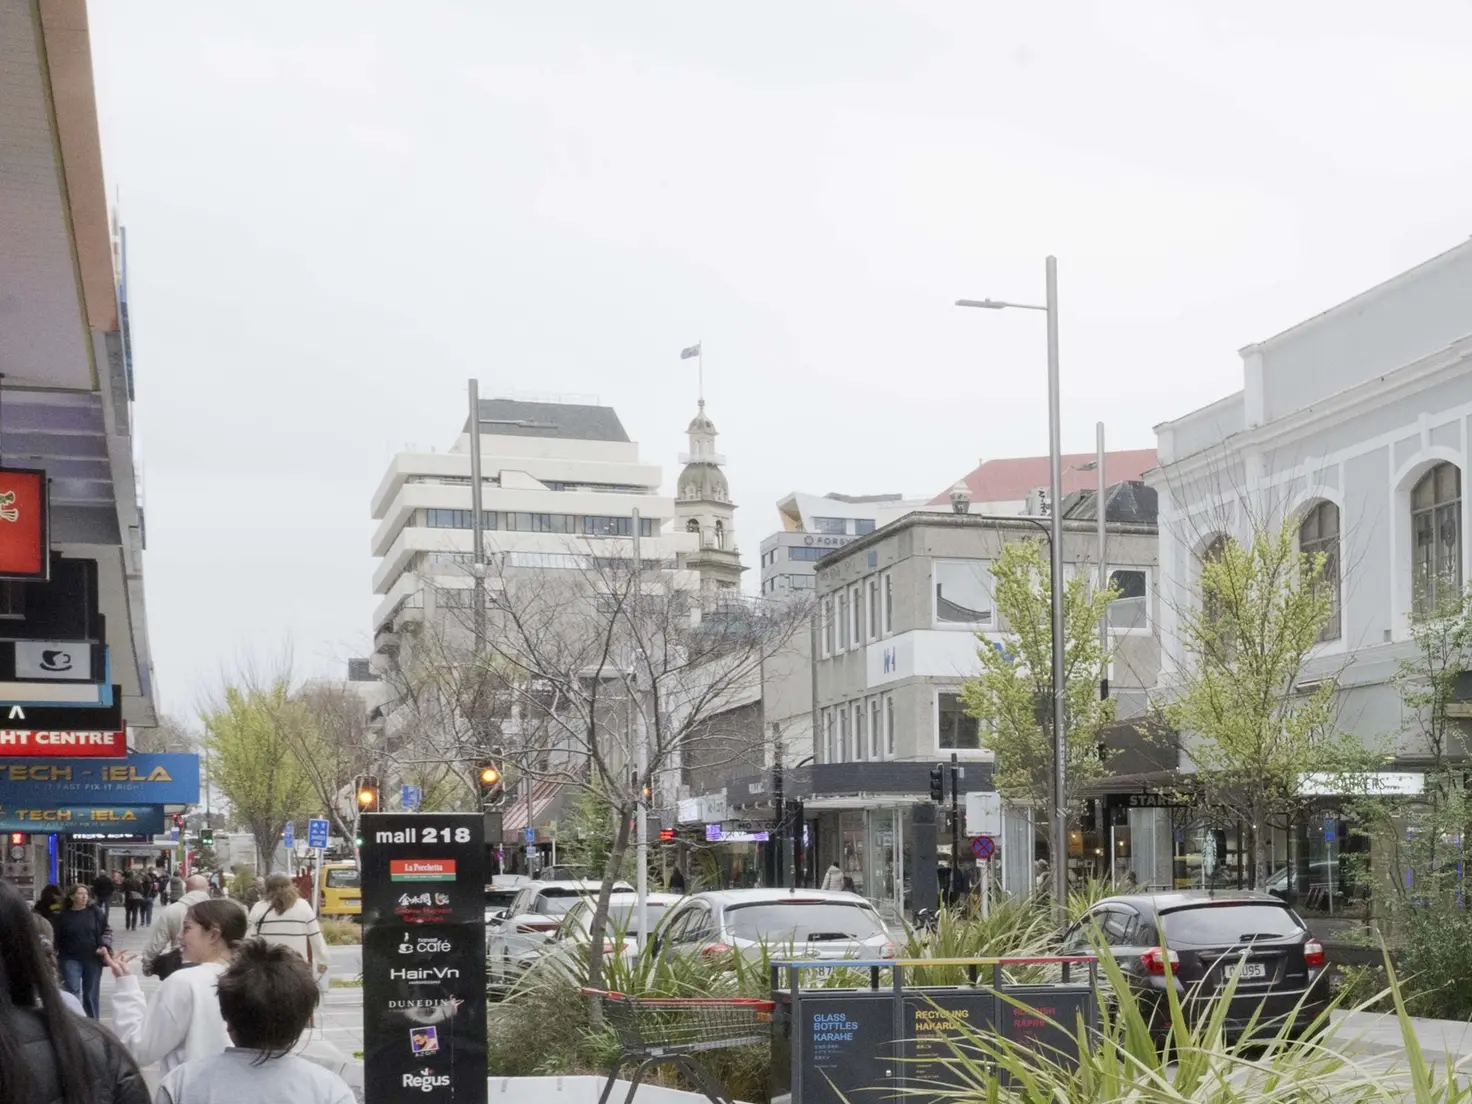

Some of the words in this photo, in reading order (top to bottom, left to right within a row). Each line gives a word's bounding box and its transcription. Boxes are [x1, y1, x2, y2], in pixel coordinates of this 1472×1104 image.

[817, 537, 855, 546] FORSY
[35, 730, 115, 745] CENTRE
[84, 783, 101, 791] FIX
[103, 783, 113, 791] IT
[16, 809, 73, 821] TECH
[376, 828, 417, 843] mall
[421, 827, 471, 843] 218
[416, 939, 452, 953] café
[390, 966, 460, 980] HairVn
[1229, 965, 1261, 976] U95
[388, 999, 449, 1009] DUNEDIN
[813, 1013, 846, 1022] GLASS
[915, 1009, 970, 1019] RECYCING
[813, 1021, 859, 1031] BOTTLES
[813, 1032, 854, 1042] KARAHE
[402, 1073, 451, 1093] Regus
